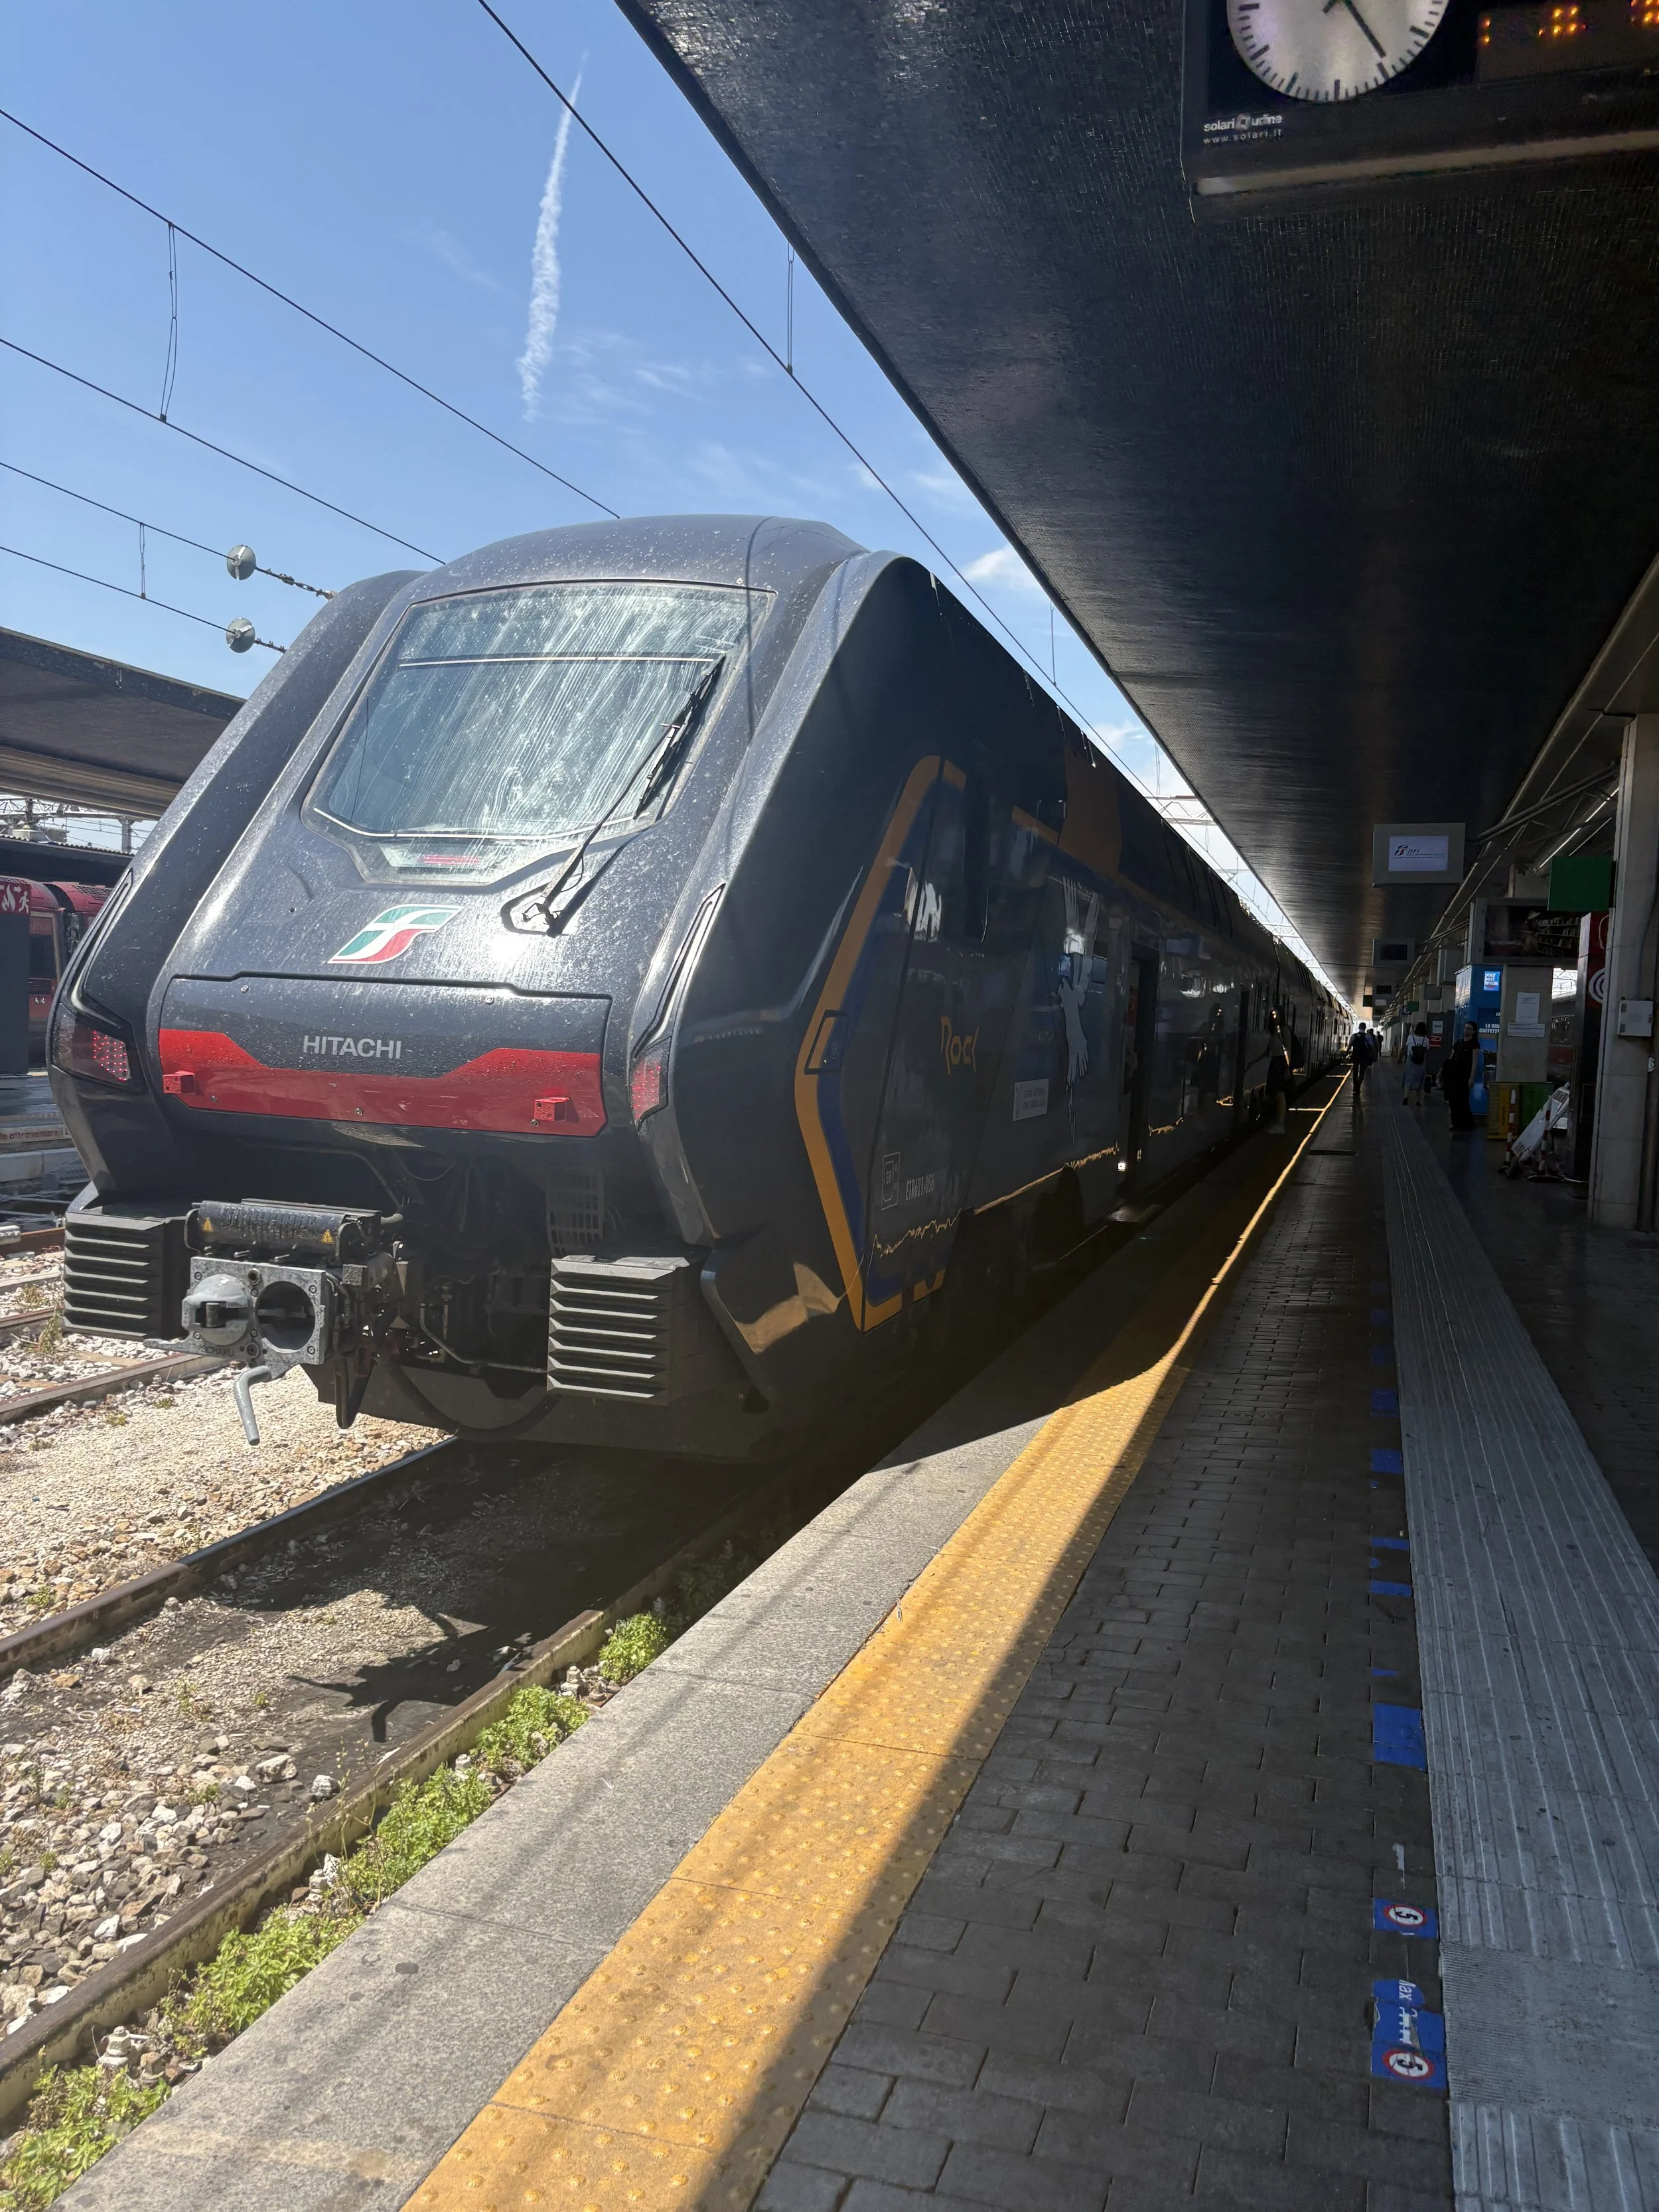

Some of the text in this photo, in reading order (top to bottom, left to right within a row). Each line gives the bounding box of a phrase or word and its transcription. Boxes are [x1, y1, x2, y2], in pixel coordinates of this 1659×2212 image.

[1204, 117, 1235, 132] solari
[303, 1035, 401, 1059] HITACHI
[1395, 1911, 1419, 1921] 5
